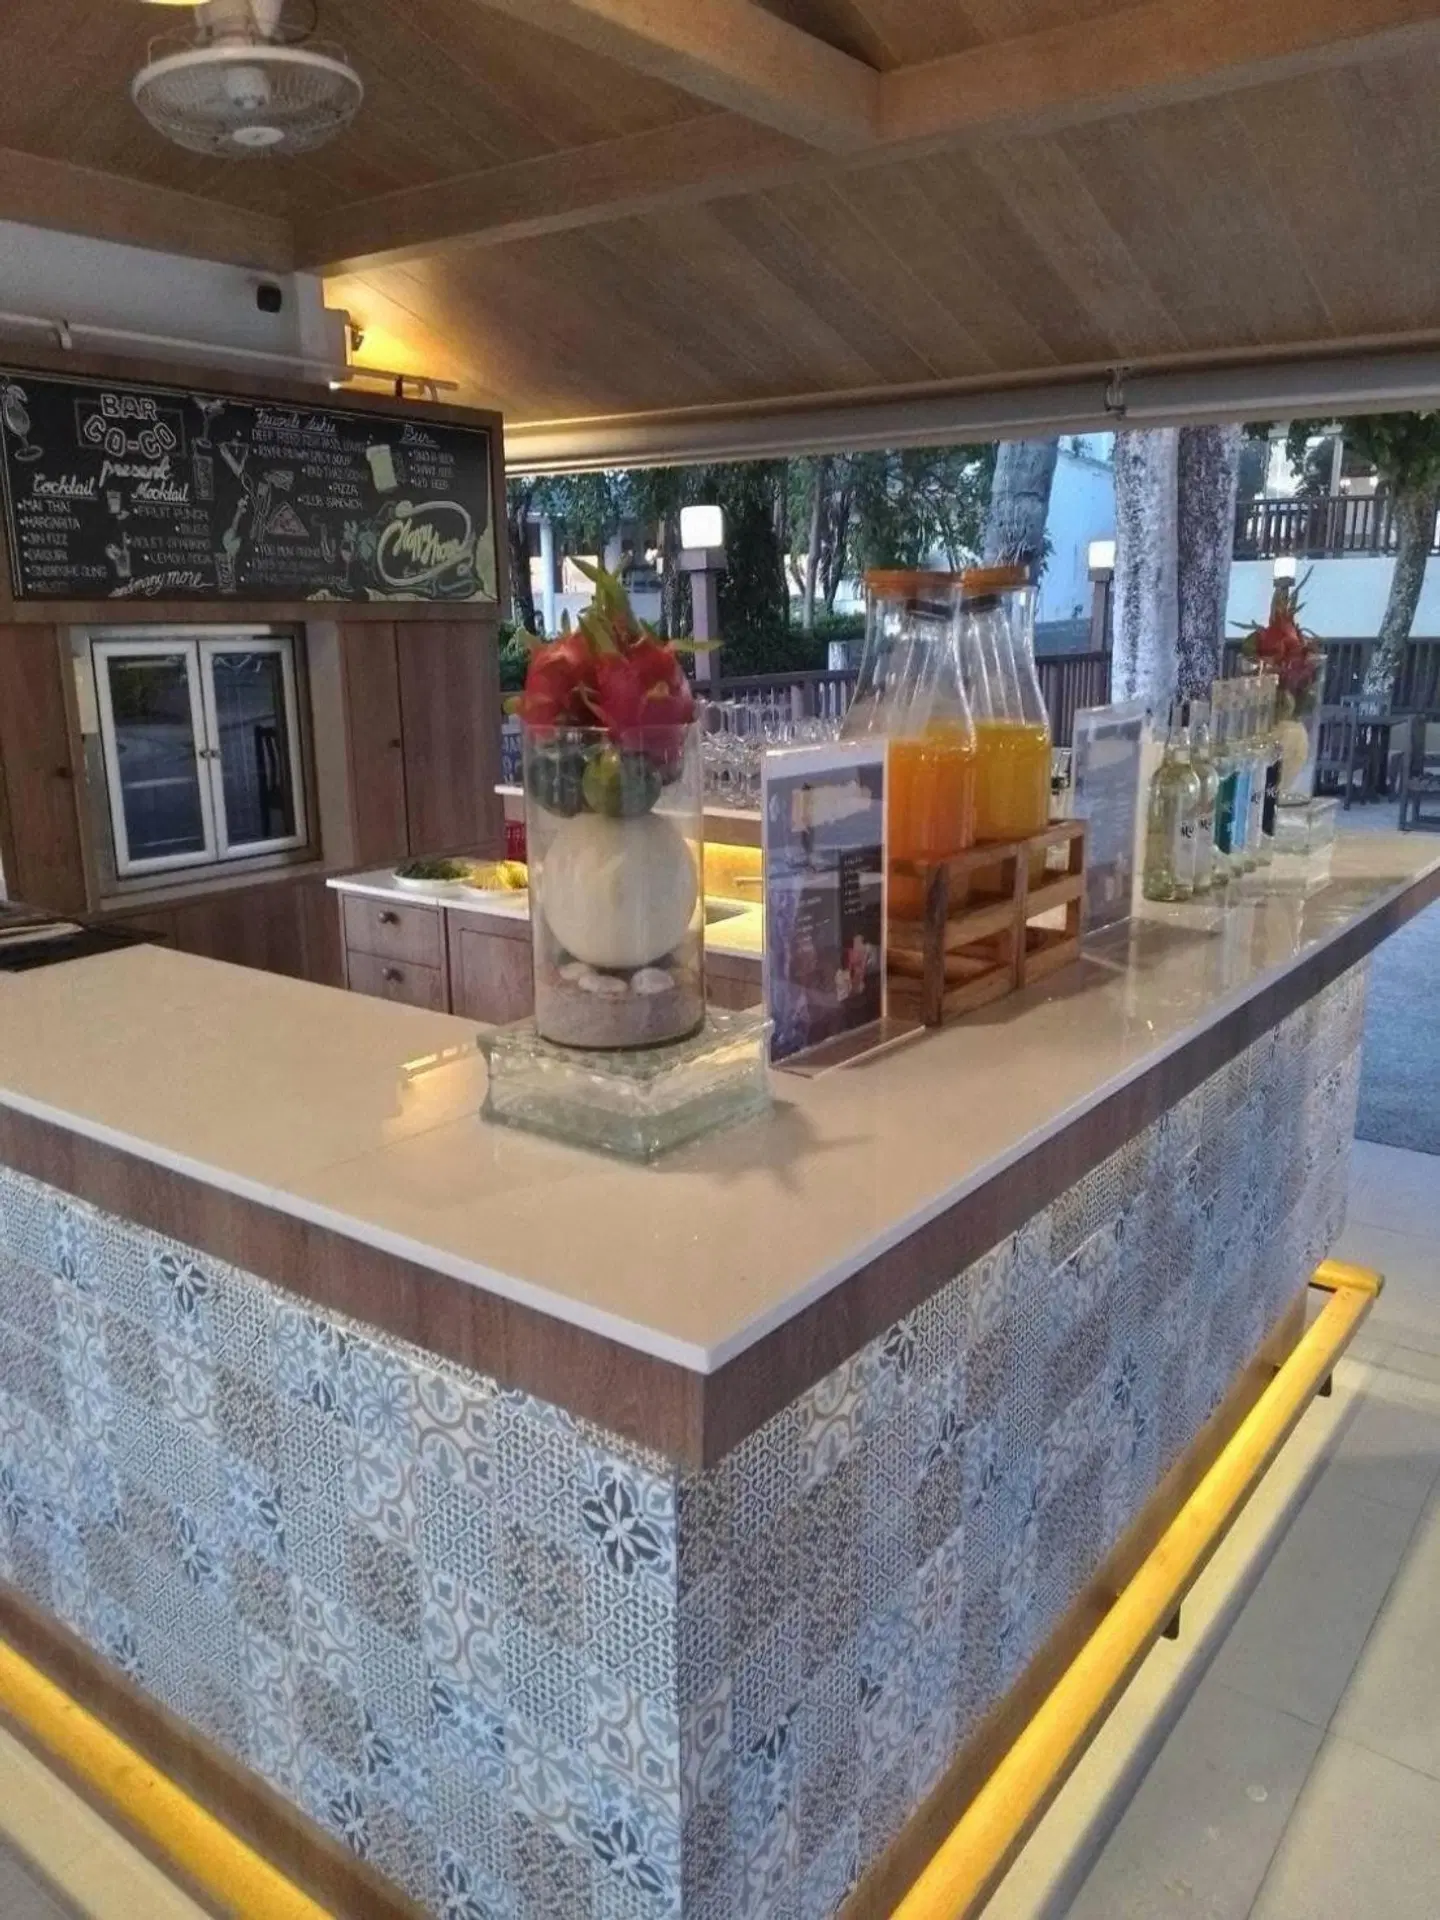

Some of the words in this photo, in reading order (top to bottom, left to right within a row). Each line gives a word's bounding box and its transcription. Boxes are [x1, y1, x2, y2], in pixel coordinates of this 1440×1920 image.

[100, 394, 157, 421] BAR
[83, 415, 177, 459] CO-CO
[99, 456, 173, 487] present
[32, 473, 96, 496] Cocktail
[131, 481, 190, 503] Mocktail
[333, 482, 359, 496] PIZZA
[167, 571, 205, 588] more
